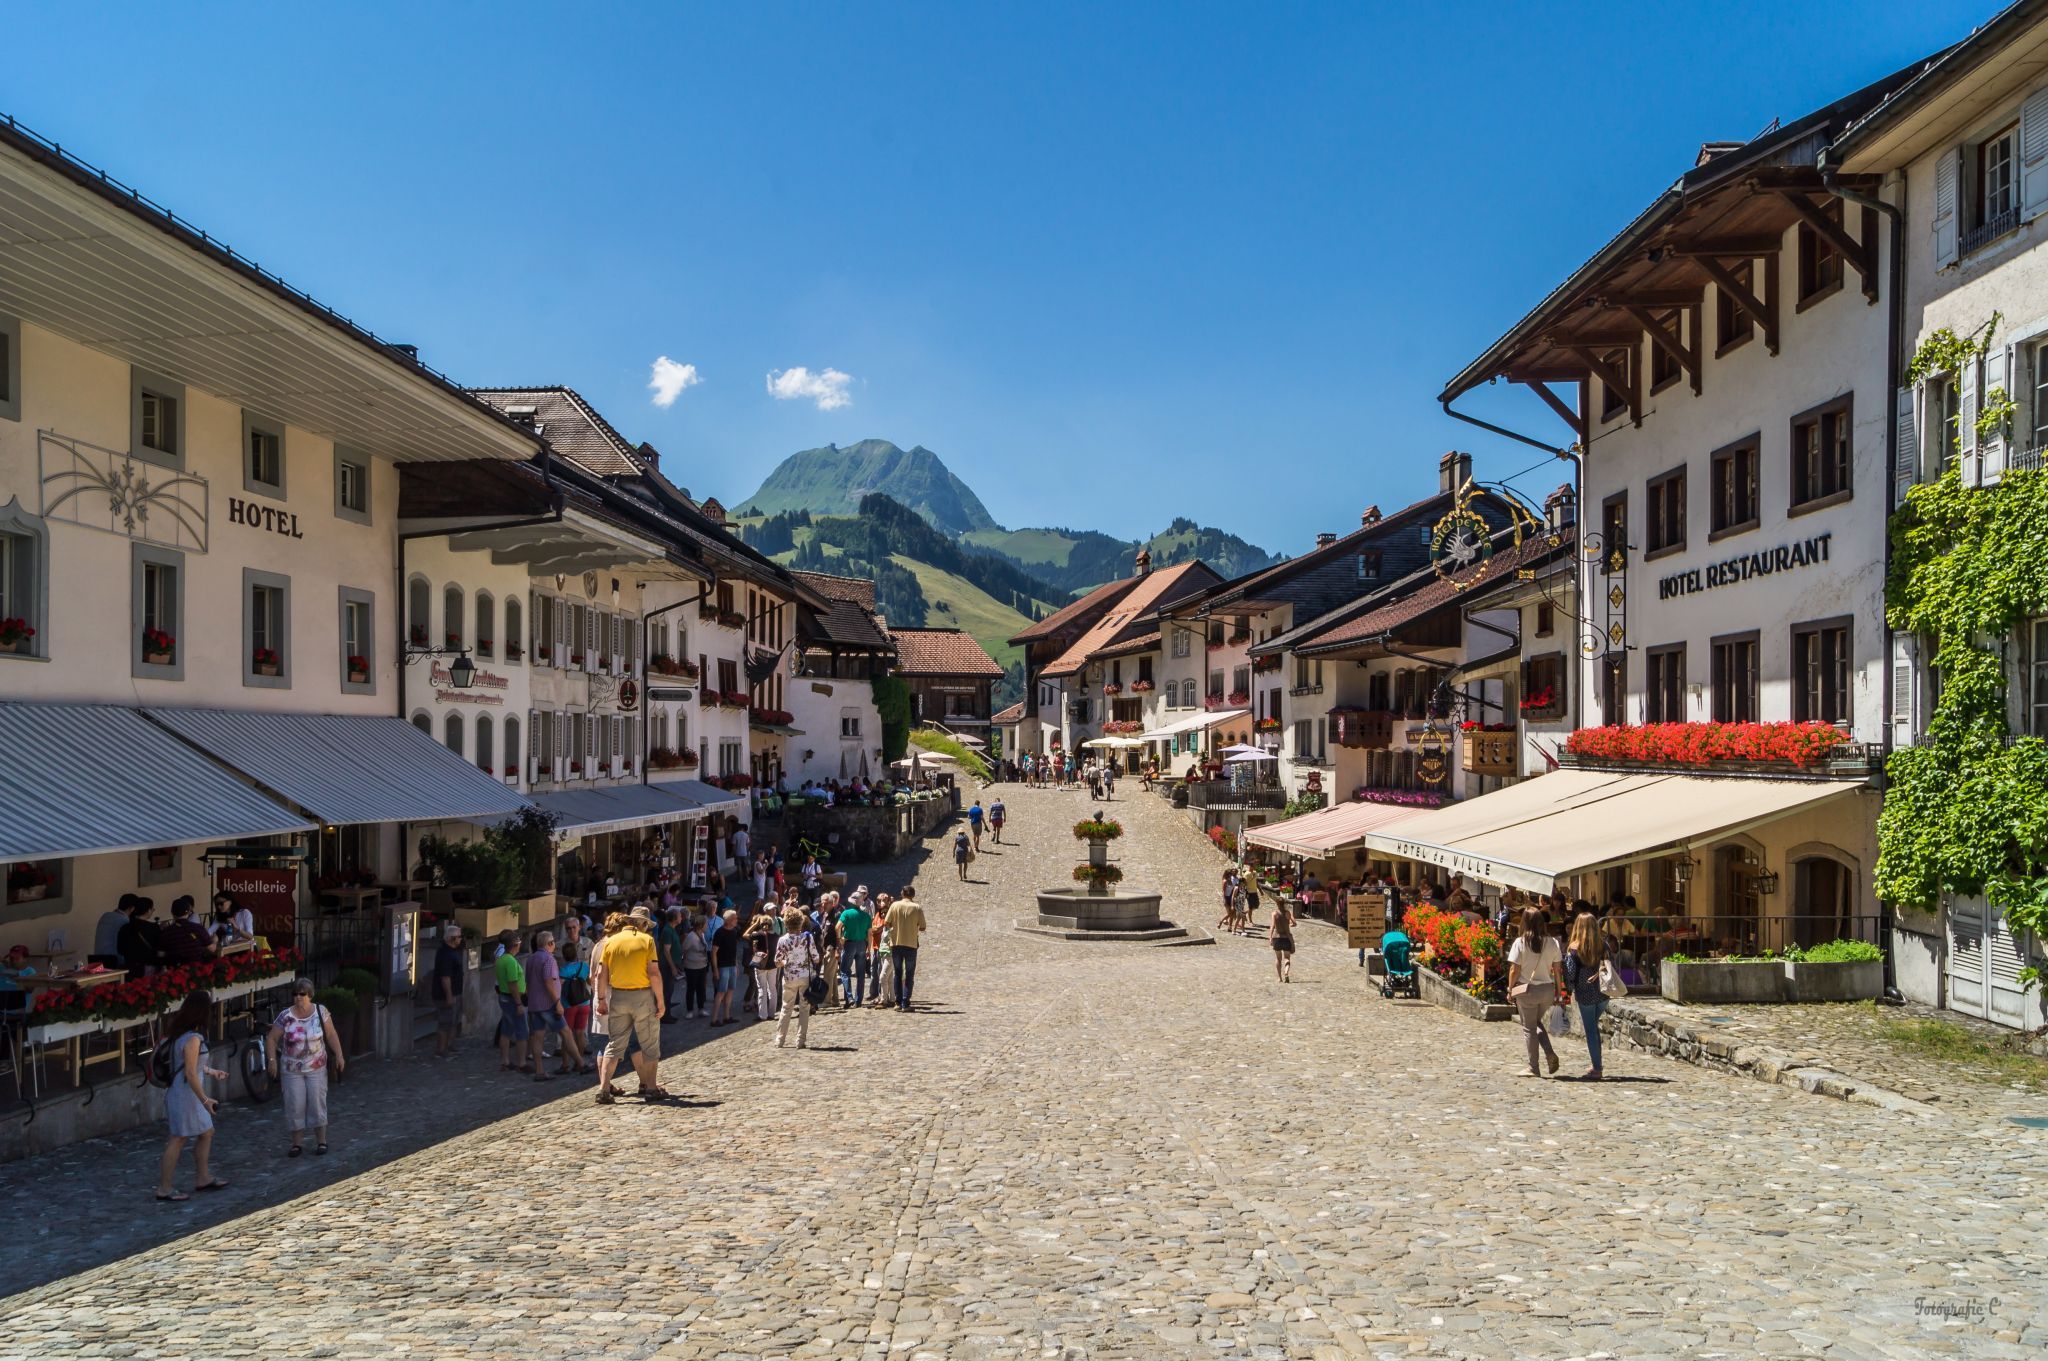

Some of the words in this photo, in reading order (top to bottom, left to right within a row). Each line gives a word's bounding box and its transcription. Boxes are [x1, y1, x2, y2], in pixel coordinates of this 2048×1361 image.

[229, 497, 303, 539] HOTEL
[1432, 522, 1454, 551] HOTEL
[1457, 518, 1471, 528] DE
[1473, 523, 1492, 549] VILLE
[1659, 569, 1704, 600] HOTEL
[1706, 532, 1832, 588] RESTAURANT
[1397, 842, 1426, 859] HOTEL
[1433, 850, 1444, 863] de
[1453, 855, 1491, 875] VILLE
[223, 878, 287, 893] Hostellerie
